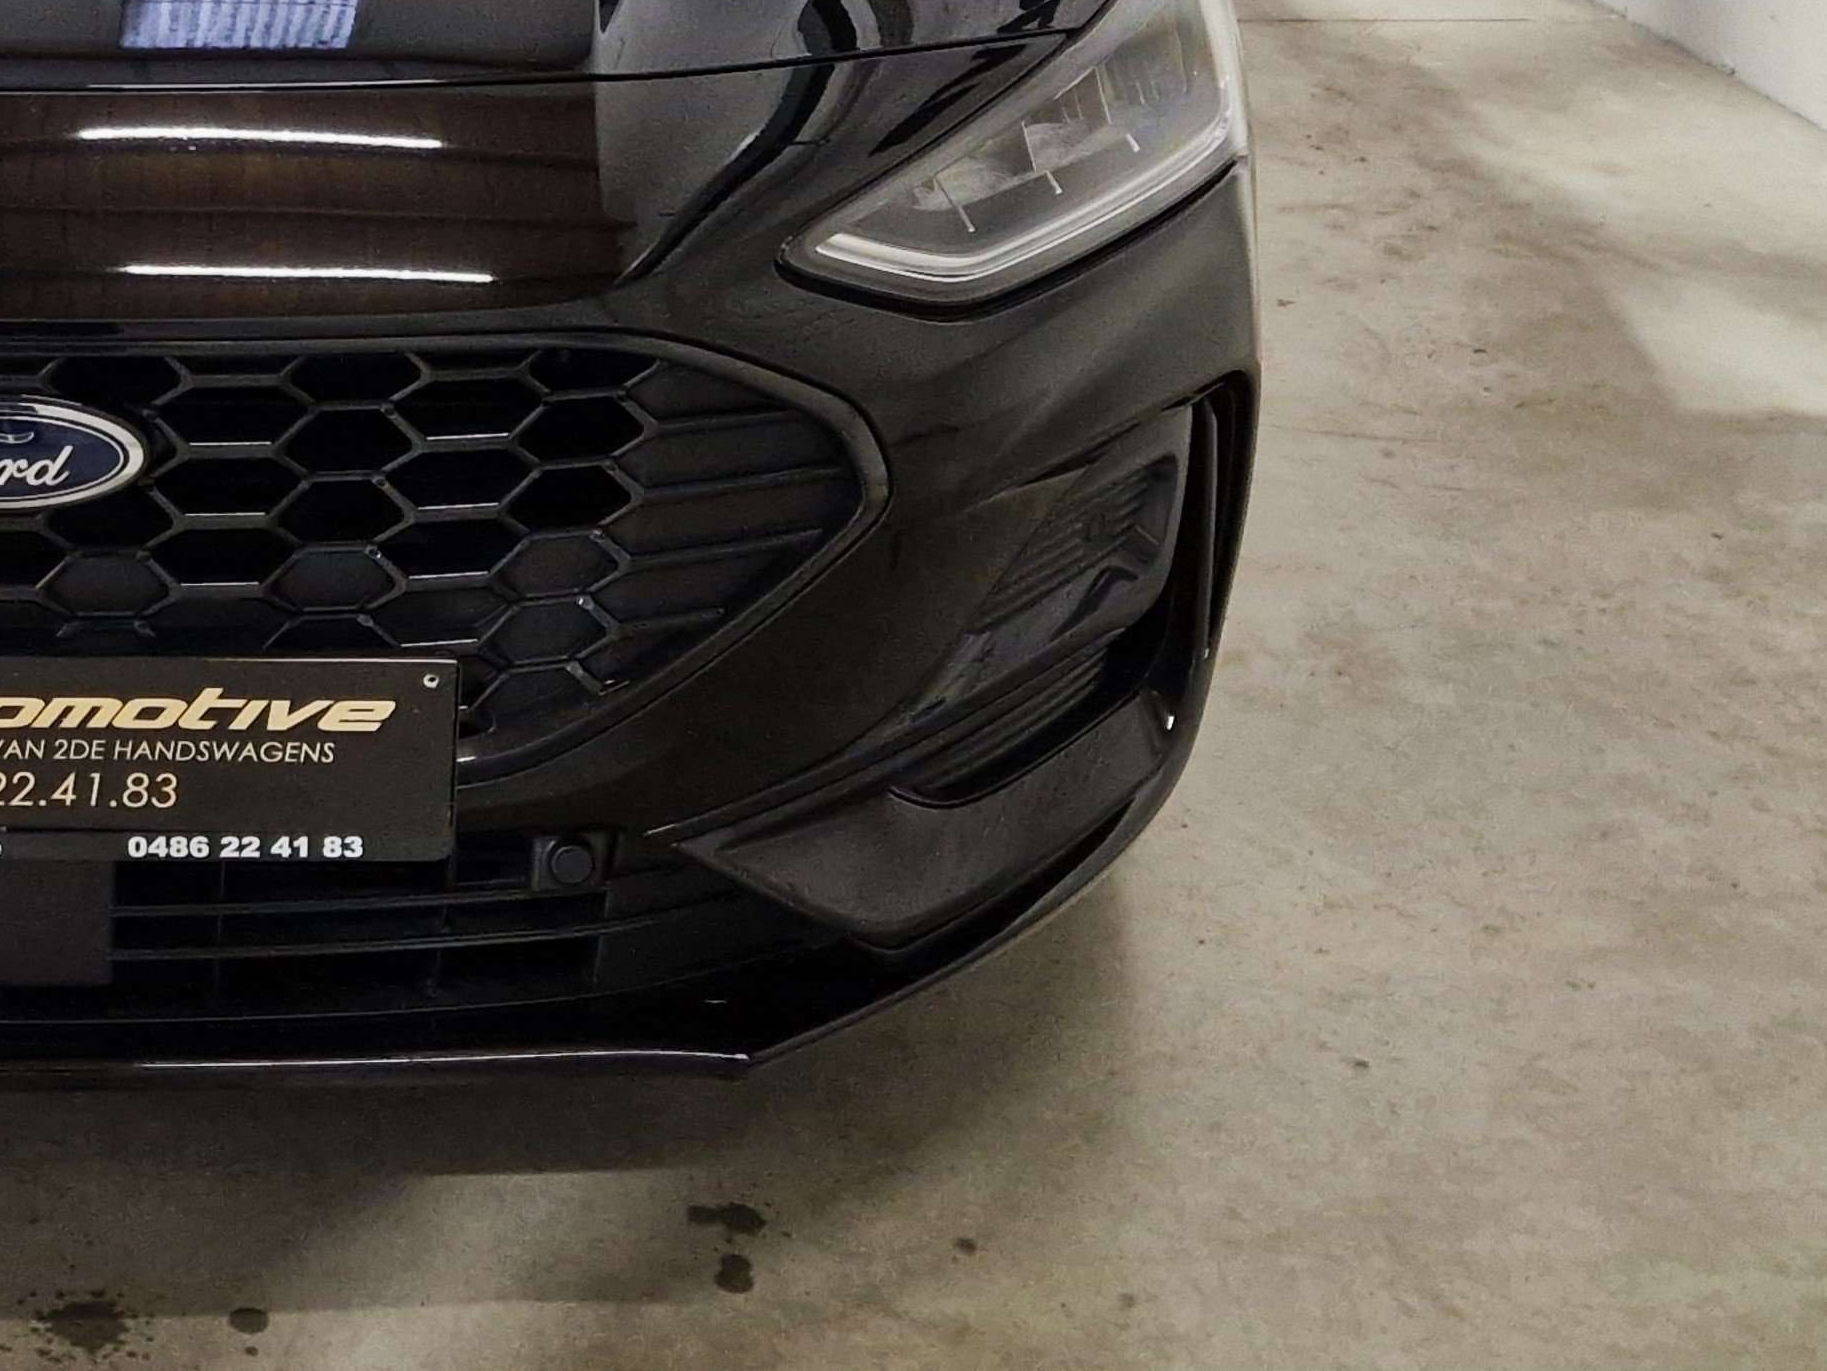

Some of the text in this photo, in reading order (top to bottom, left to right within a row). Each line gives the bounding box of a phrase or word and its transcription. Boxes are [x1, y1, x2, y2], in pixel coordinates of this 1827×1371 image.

[53, 739, 107, 761] 2DE
[113, 739, 335, 764] HANDSWAGENS
[127, 835, 364, 858] 0486 22 41 83
